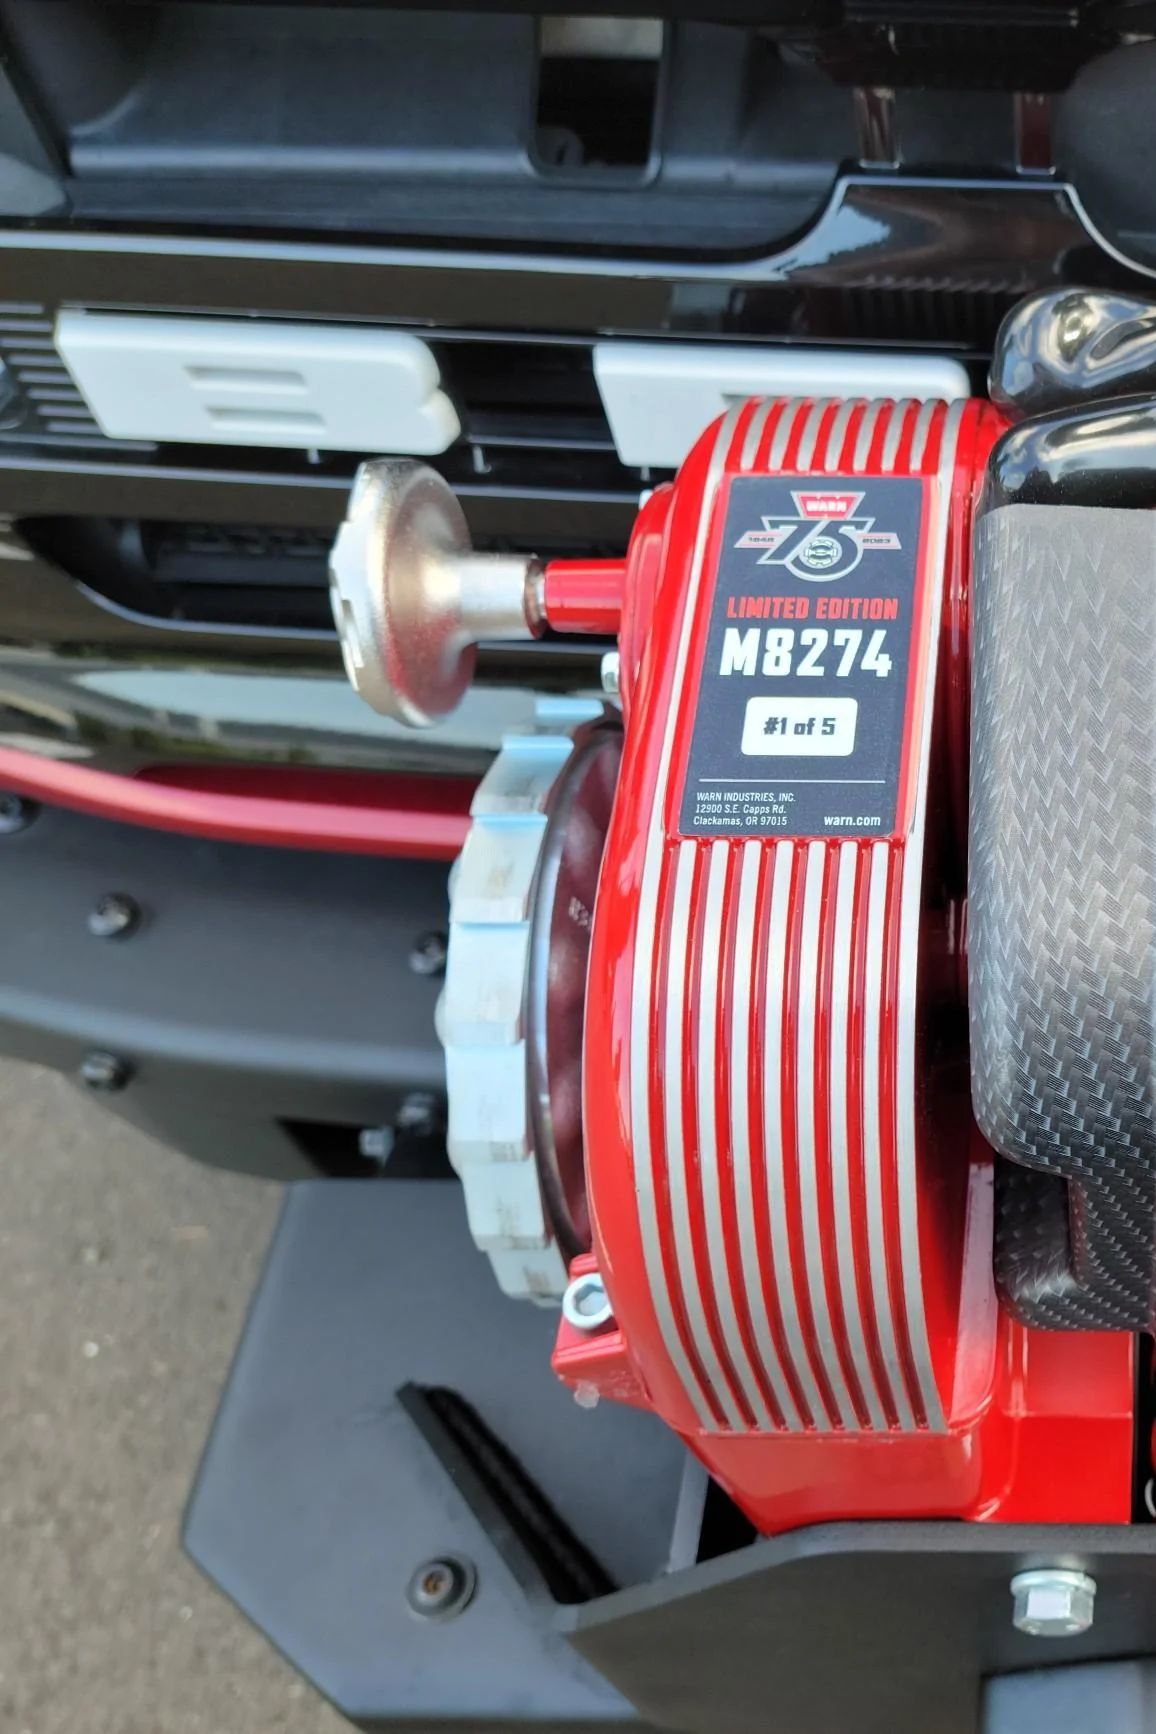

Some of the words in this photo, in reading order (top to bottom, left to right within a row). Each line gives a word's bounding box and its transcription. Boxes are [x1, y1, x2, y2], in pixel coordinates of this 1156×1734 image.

[806, 502, 846, 512] WARN
[727, 597, 810, 618] LIMITED
[816, 598, 898, 620] EDITION
[719, 628, 892, 677] M8274
[763, 717, 788, 735] #1
[793, 717, 816, 735] of
[821, 717, 836, 735] 5
[696, 792, 722, 801] WARN
[723, 792, 777, 803] INDUSTRIES,
[778, 793, 796, 802] INC.
[695, 804, 722, 813] 12900
[724, 804, 740, 814] S.E.
[743, 804, 770, 815] Capps
[772, 805, 787, 814] Rd.
[693, 816, 743, 827] Clackamas,
[745, 817, 758, 826] OR
[760, 817, 788, 826] 97015
[823, 816, 881, 826] warn.com
